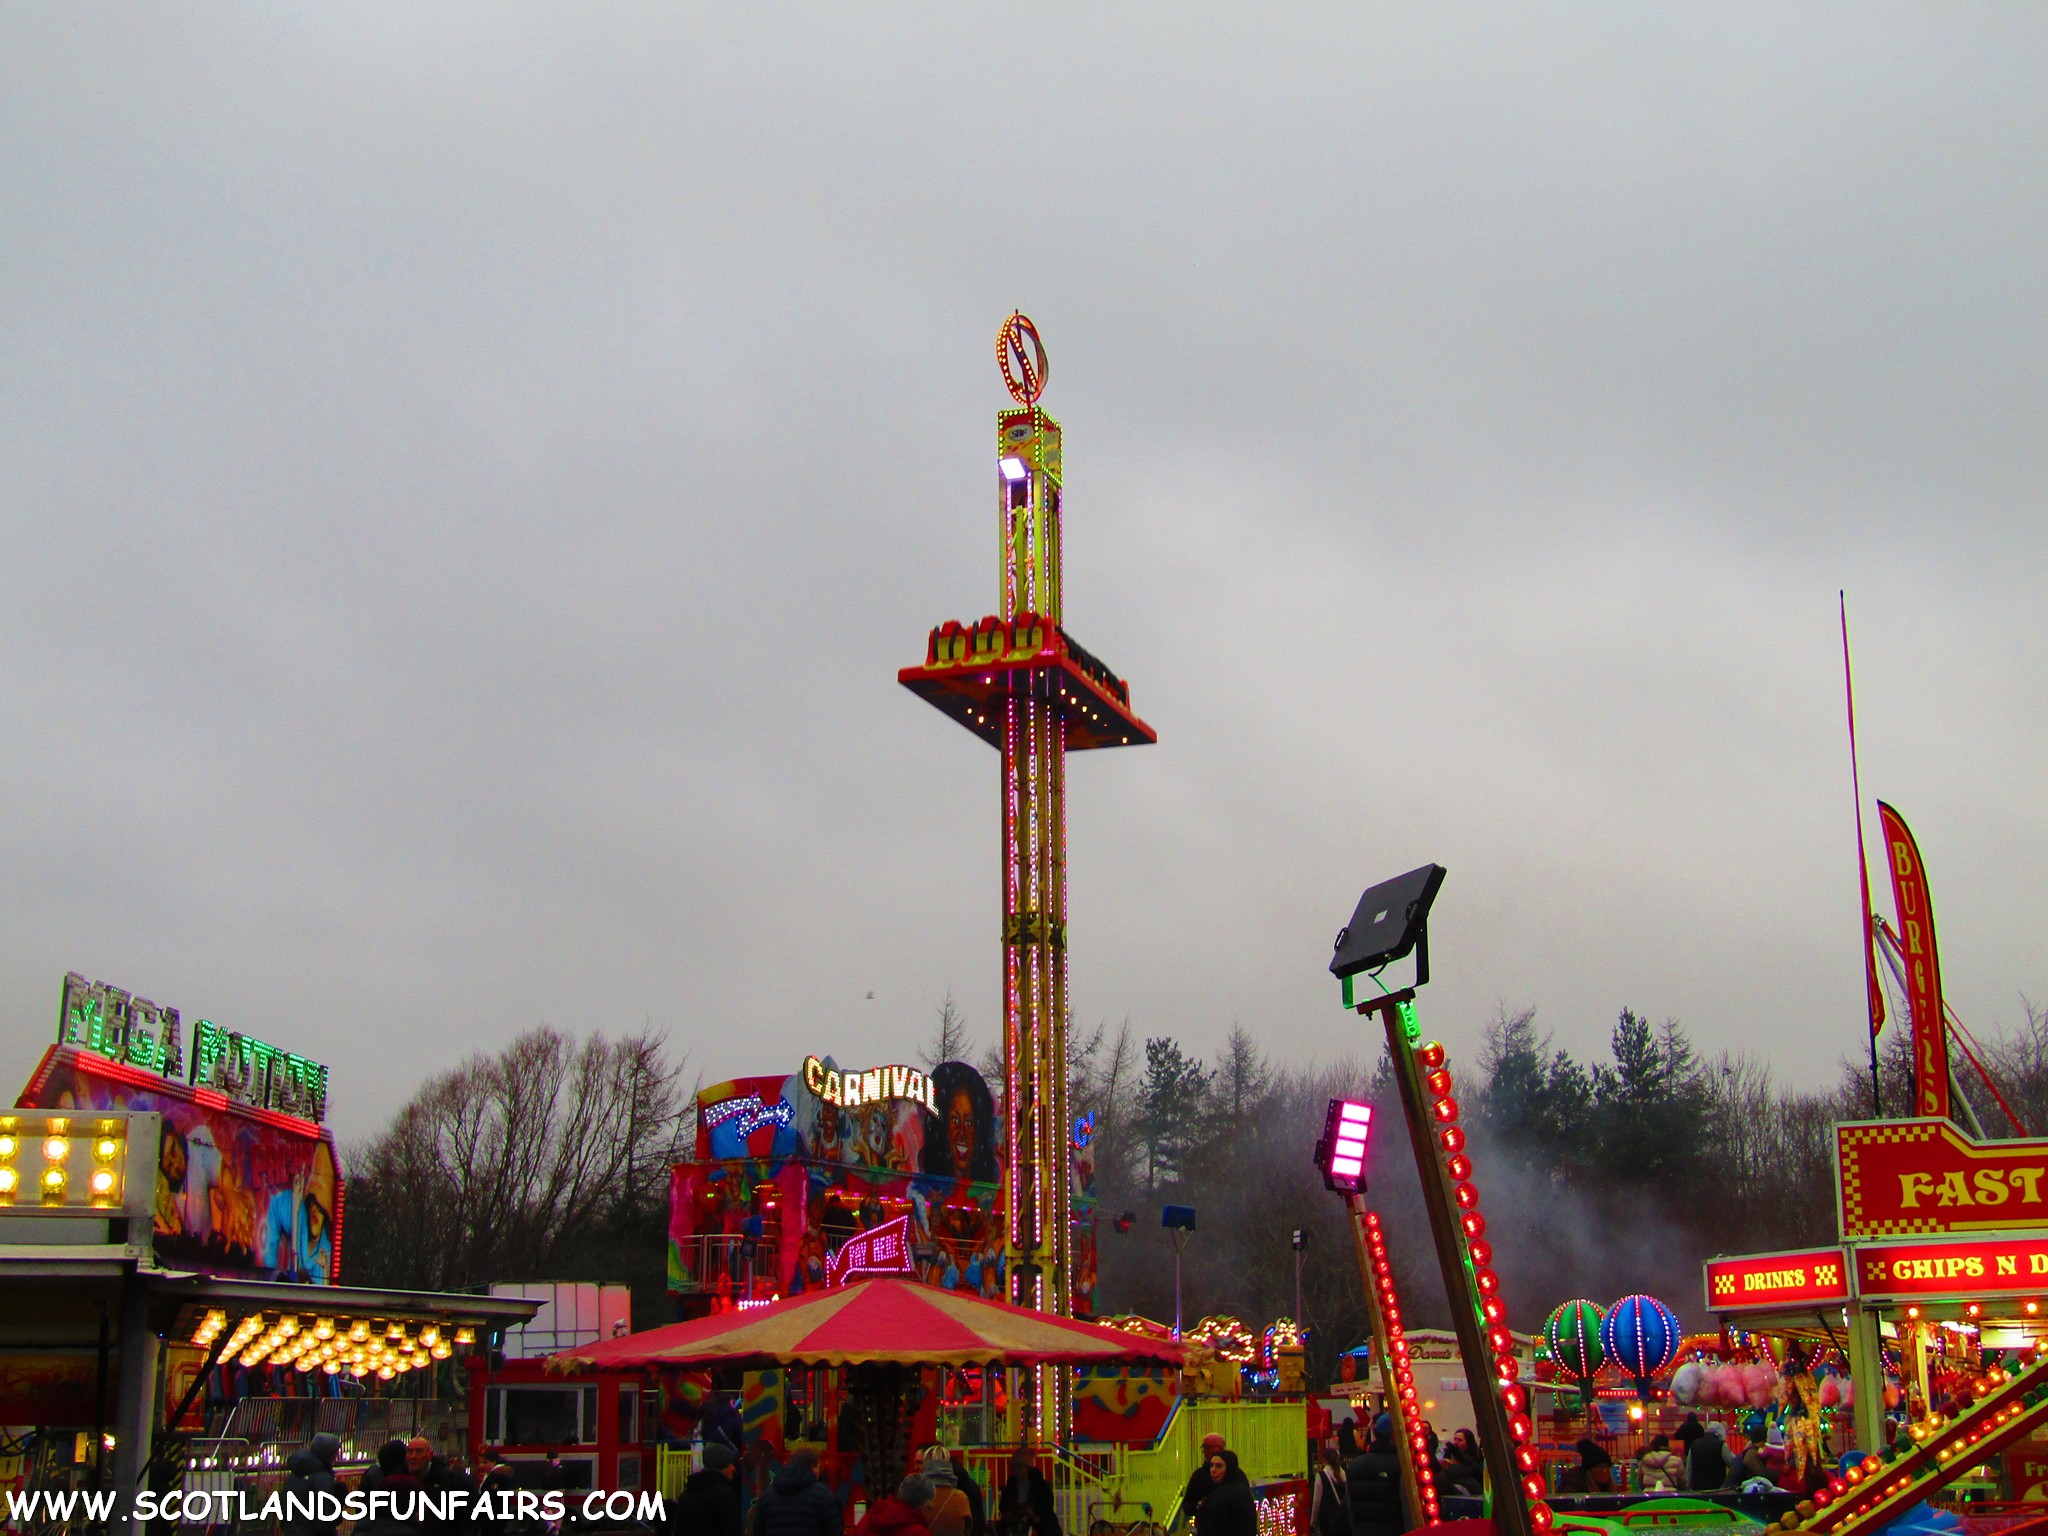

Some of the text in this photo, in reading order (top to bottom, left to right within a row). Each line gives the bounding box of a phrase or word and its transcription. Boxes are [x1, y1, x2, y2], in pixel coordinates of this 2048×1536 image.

[62, 970, 184, 1078] MEGA
[804, 1055, 939, 1118] CARNIVAL
[1897, 1167, 2045, 1209] FAST
[1743, 1268, 1806, 1292] DRINKS
[1892, 1256, 1985, 1280] CHIPS
[1996, 1254, 2018, 1276] N
